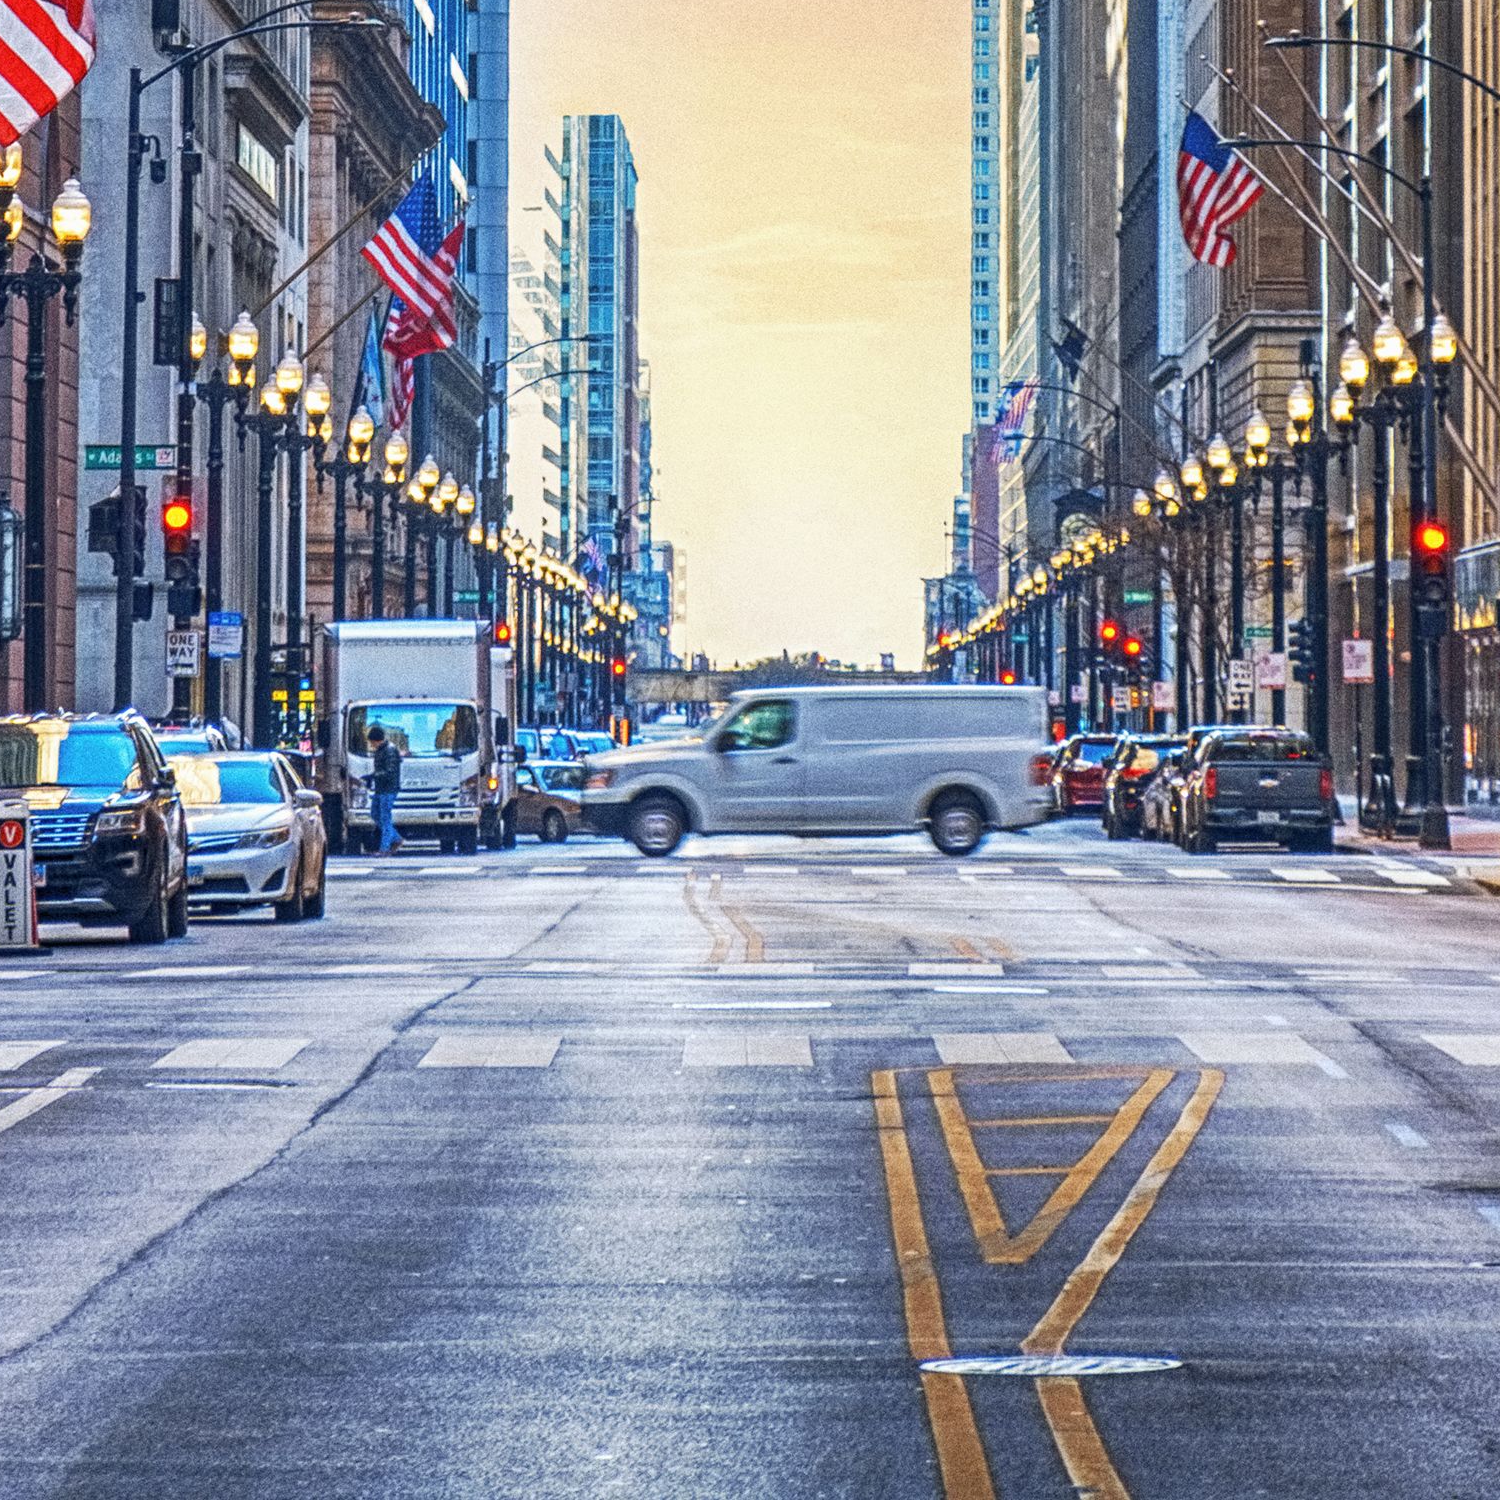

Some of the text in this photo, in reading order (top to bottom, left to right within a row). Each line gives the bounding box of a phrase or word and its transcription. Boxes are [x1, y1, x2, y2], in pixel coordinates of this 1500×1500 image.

[98, 450, 143, 464] Adas
[169, 631, 195, 646] ONE
[169, 647, 195, 658] WAY
[4, 826, 18, 843] V
[4, 853, 17, 941] VALET
